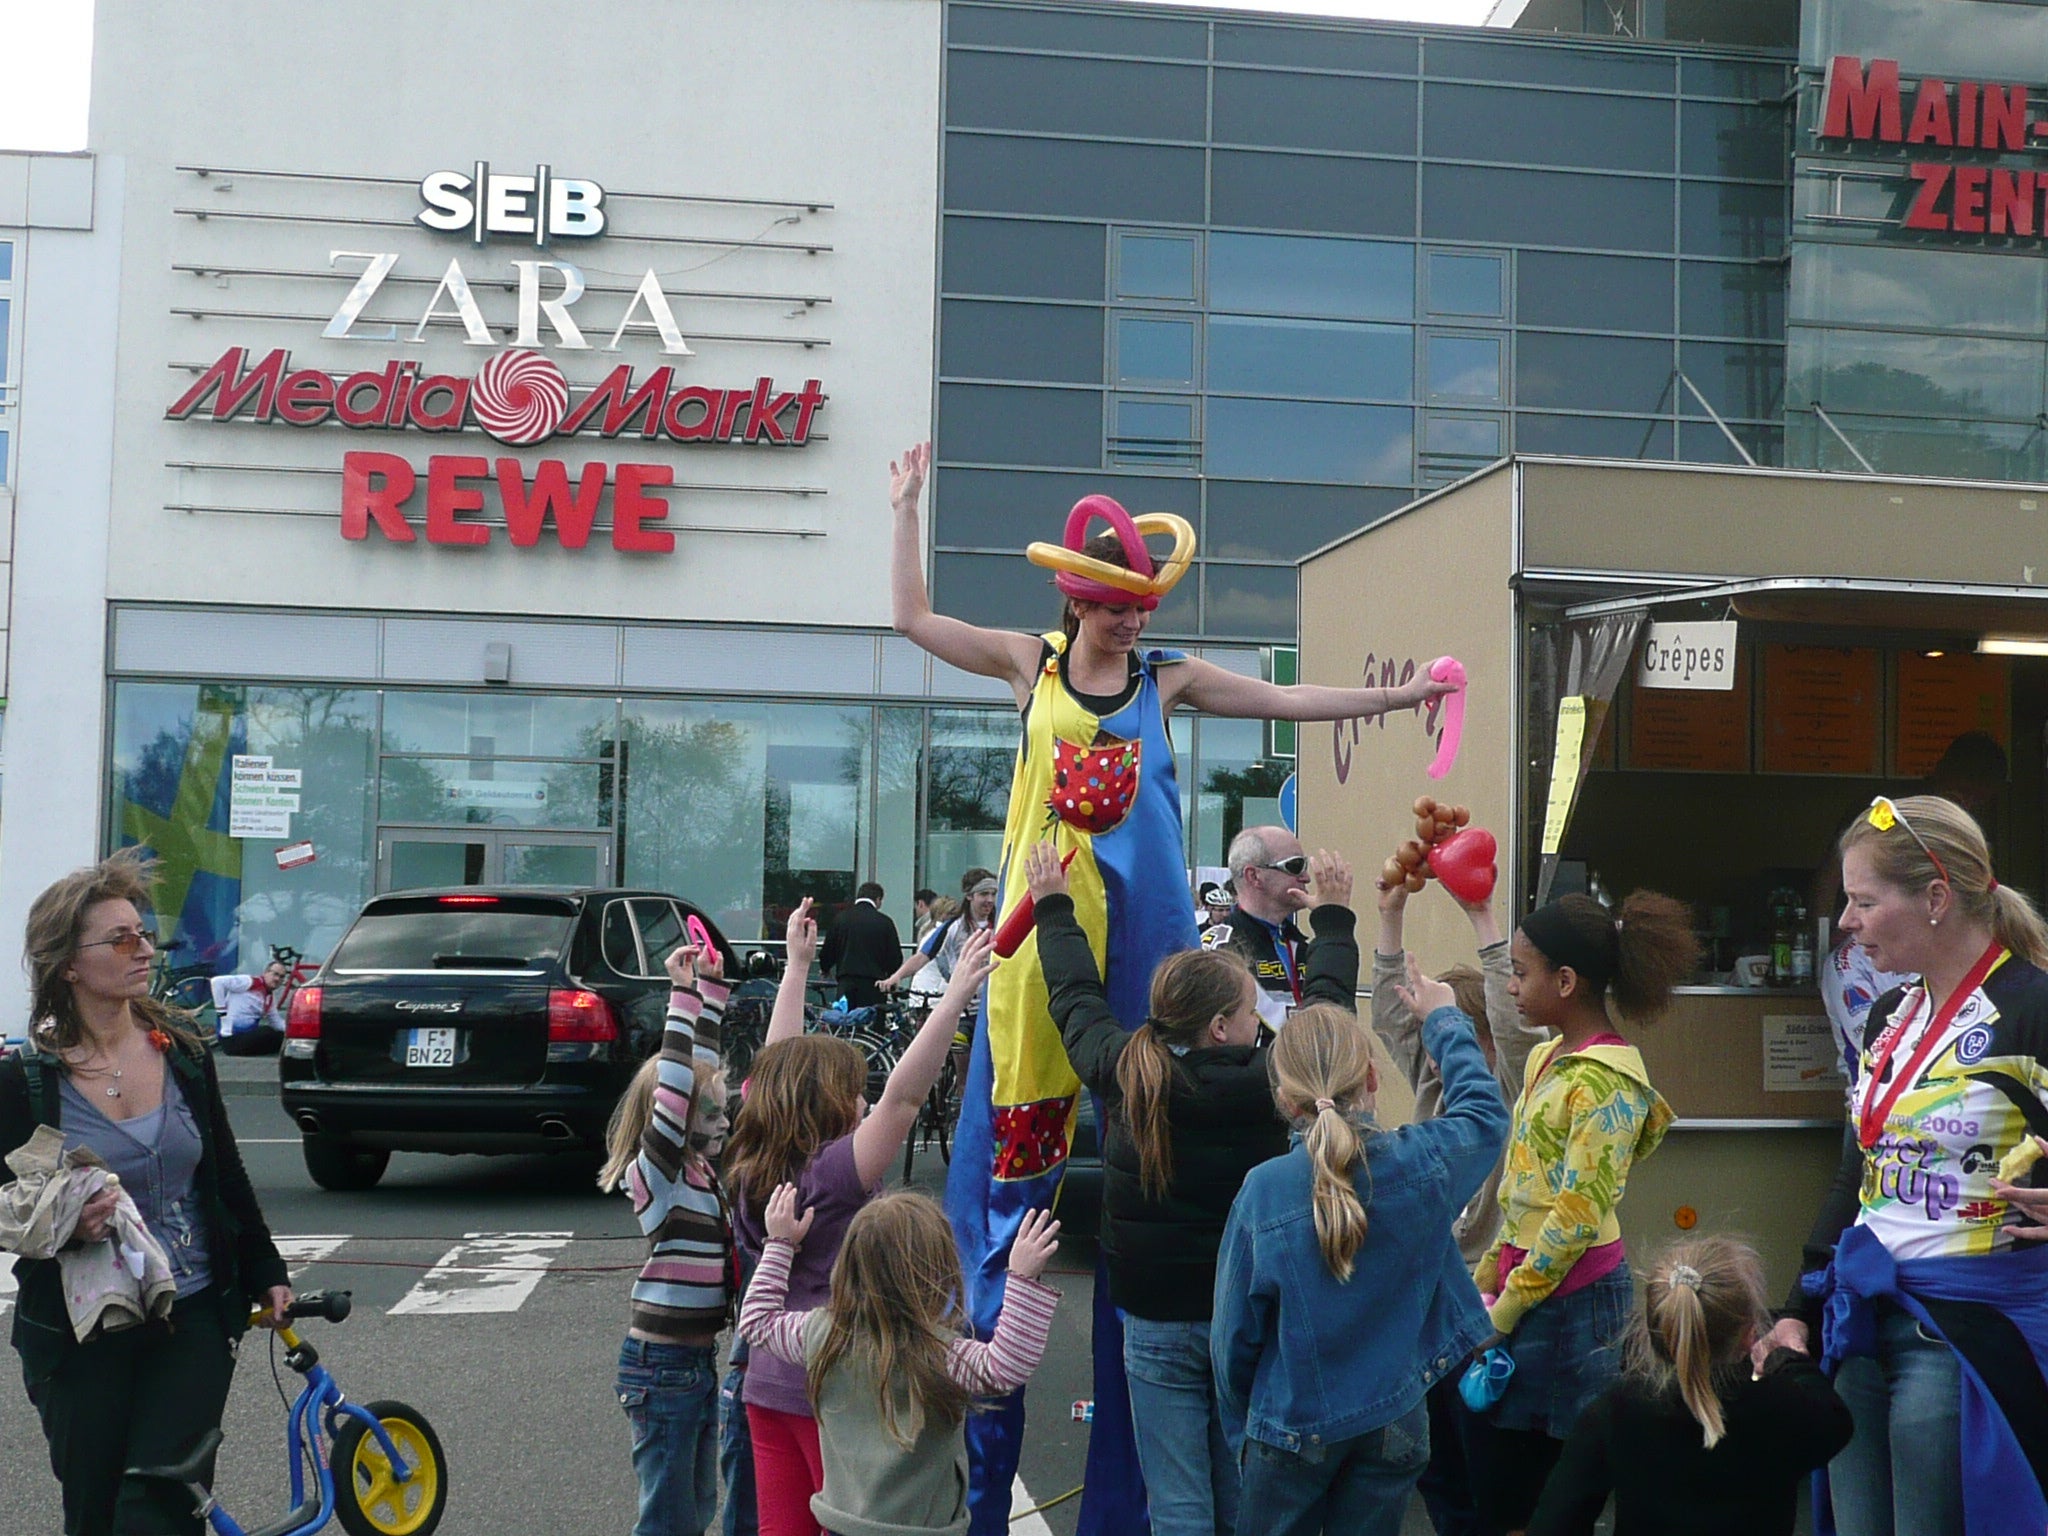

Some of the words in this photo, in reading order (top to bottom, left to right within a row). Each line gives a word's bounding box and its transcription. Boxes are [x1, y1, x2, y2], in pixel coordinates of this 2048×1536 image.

[320, 250, 696, 356] ZARA
[165, 347, 475, 432] Media
[559, 364, 829, 446] Markt
[341, 451, 675, 553] REWE
[1645, 634, 1725, 681] Crêpes
[234, 758, 268, 769] Italiener
[234, 771, 264, 782] können
[266, 772, 298, 783] küssen.
[233, 784, 276, 794] Schweden
[394, 1000, 447, 1014] Cayenne
[427, 1030, 438, 1047] F
[408, 1047, 430, 1064] BN
[432, 1047, 453, 1064] 22
[1919, 1115, 1980, 1137] 2003
